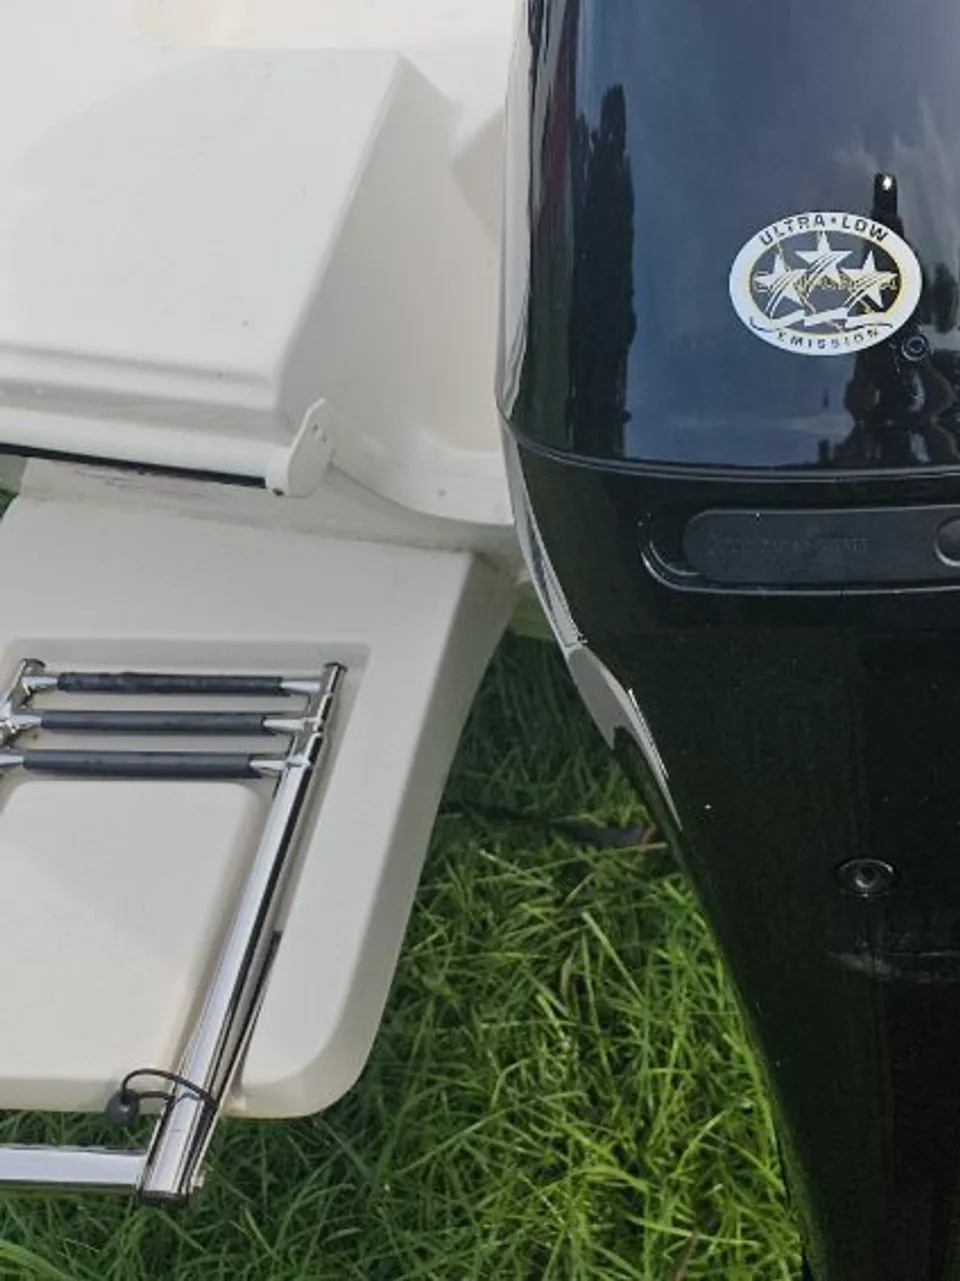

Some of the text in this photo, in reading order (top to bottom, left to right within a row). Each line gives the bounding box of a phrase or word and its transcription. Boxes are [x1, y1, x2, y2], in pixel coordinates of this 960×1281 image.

[760, 214, 890, 246] ULTRA LOW
[777, 326, 879, 350] EMISSION
